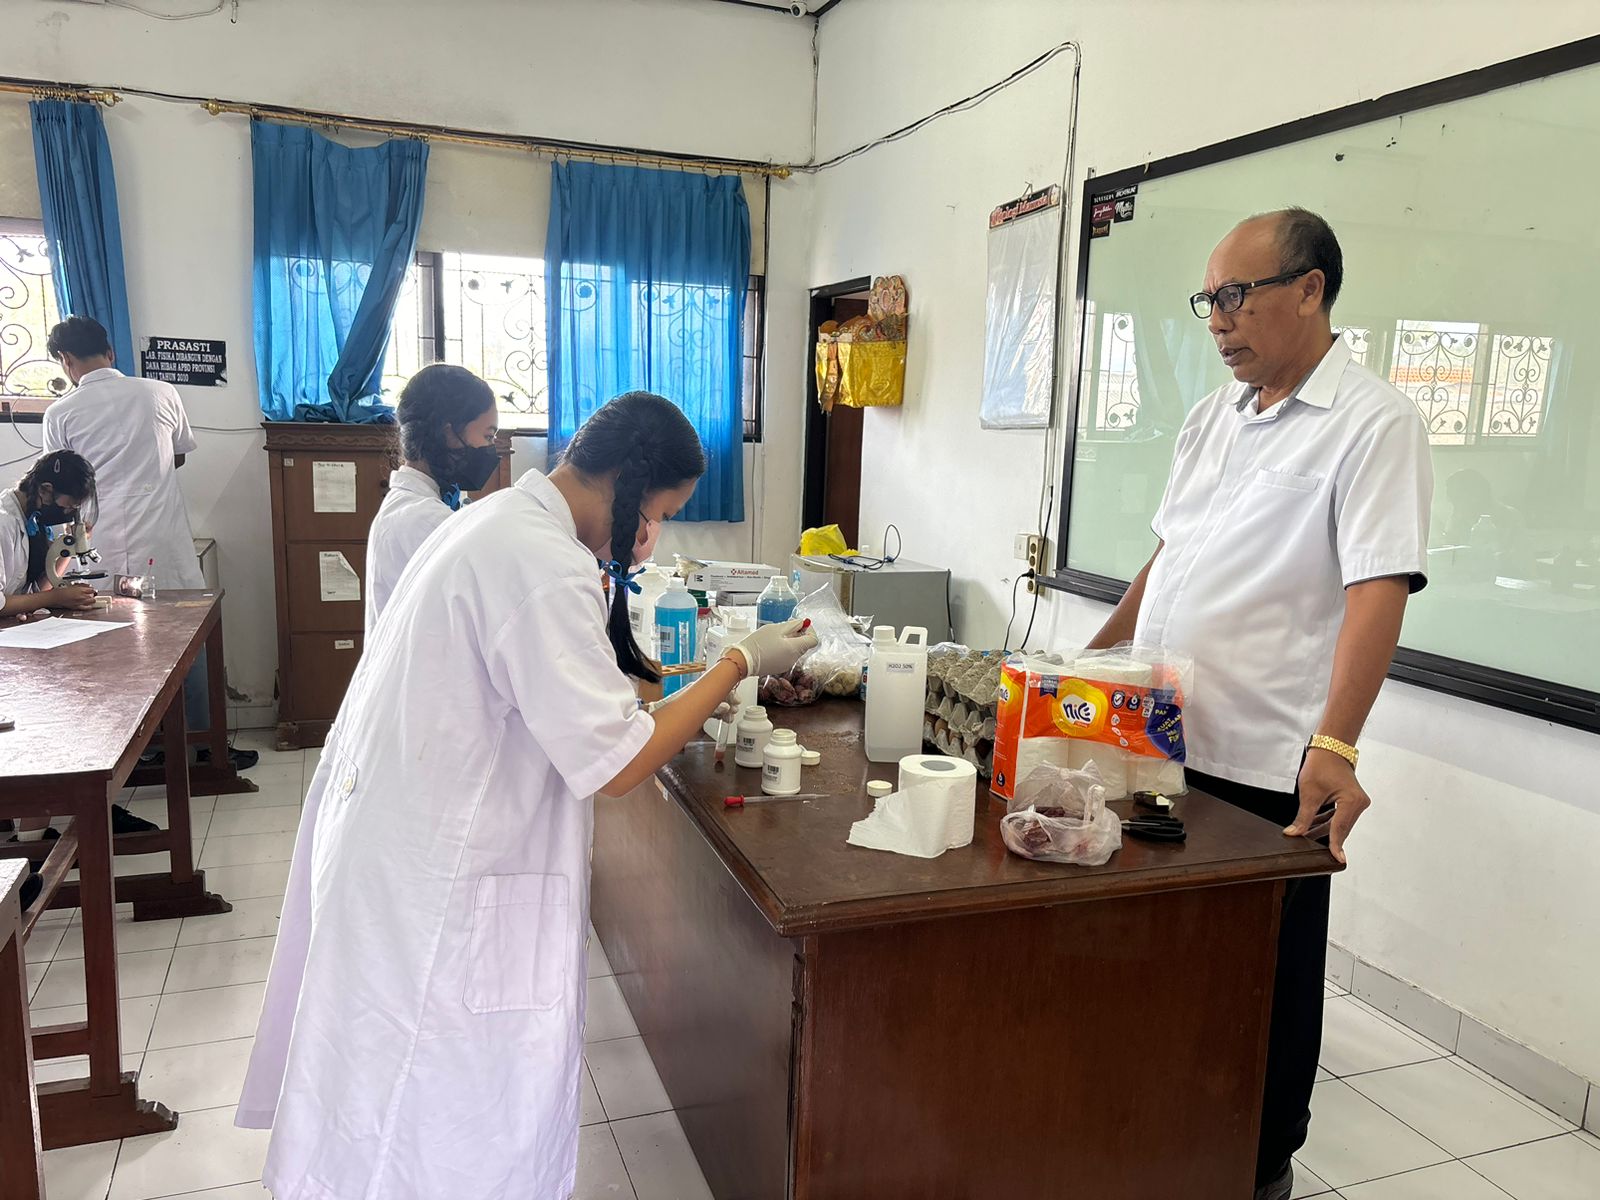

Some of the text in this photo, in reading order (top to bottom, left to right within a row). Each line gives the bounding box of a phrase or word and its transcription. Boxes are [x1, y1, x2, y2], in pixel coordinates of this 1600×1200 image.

[157, 340, 210, 352] PRASASTI
[145, 351, 223, 363] LAB. FISIKA DIBANGUN DENGAN
[145, 361, 215, 373] DANA HIBAH APBD PROVINSI
[159, 372, 177, 381] TAHUN
[737, 568, 759, 576] Altamed
